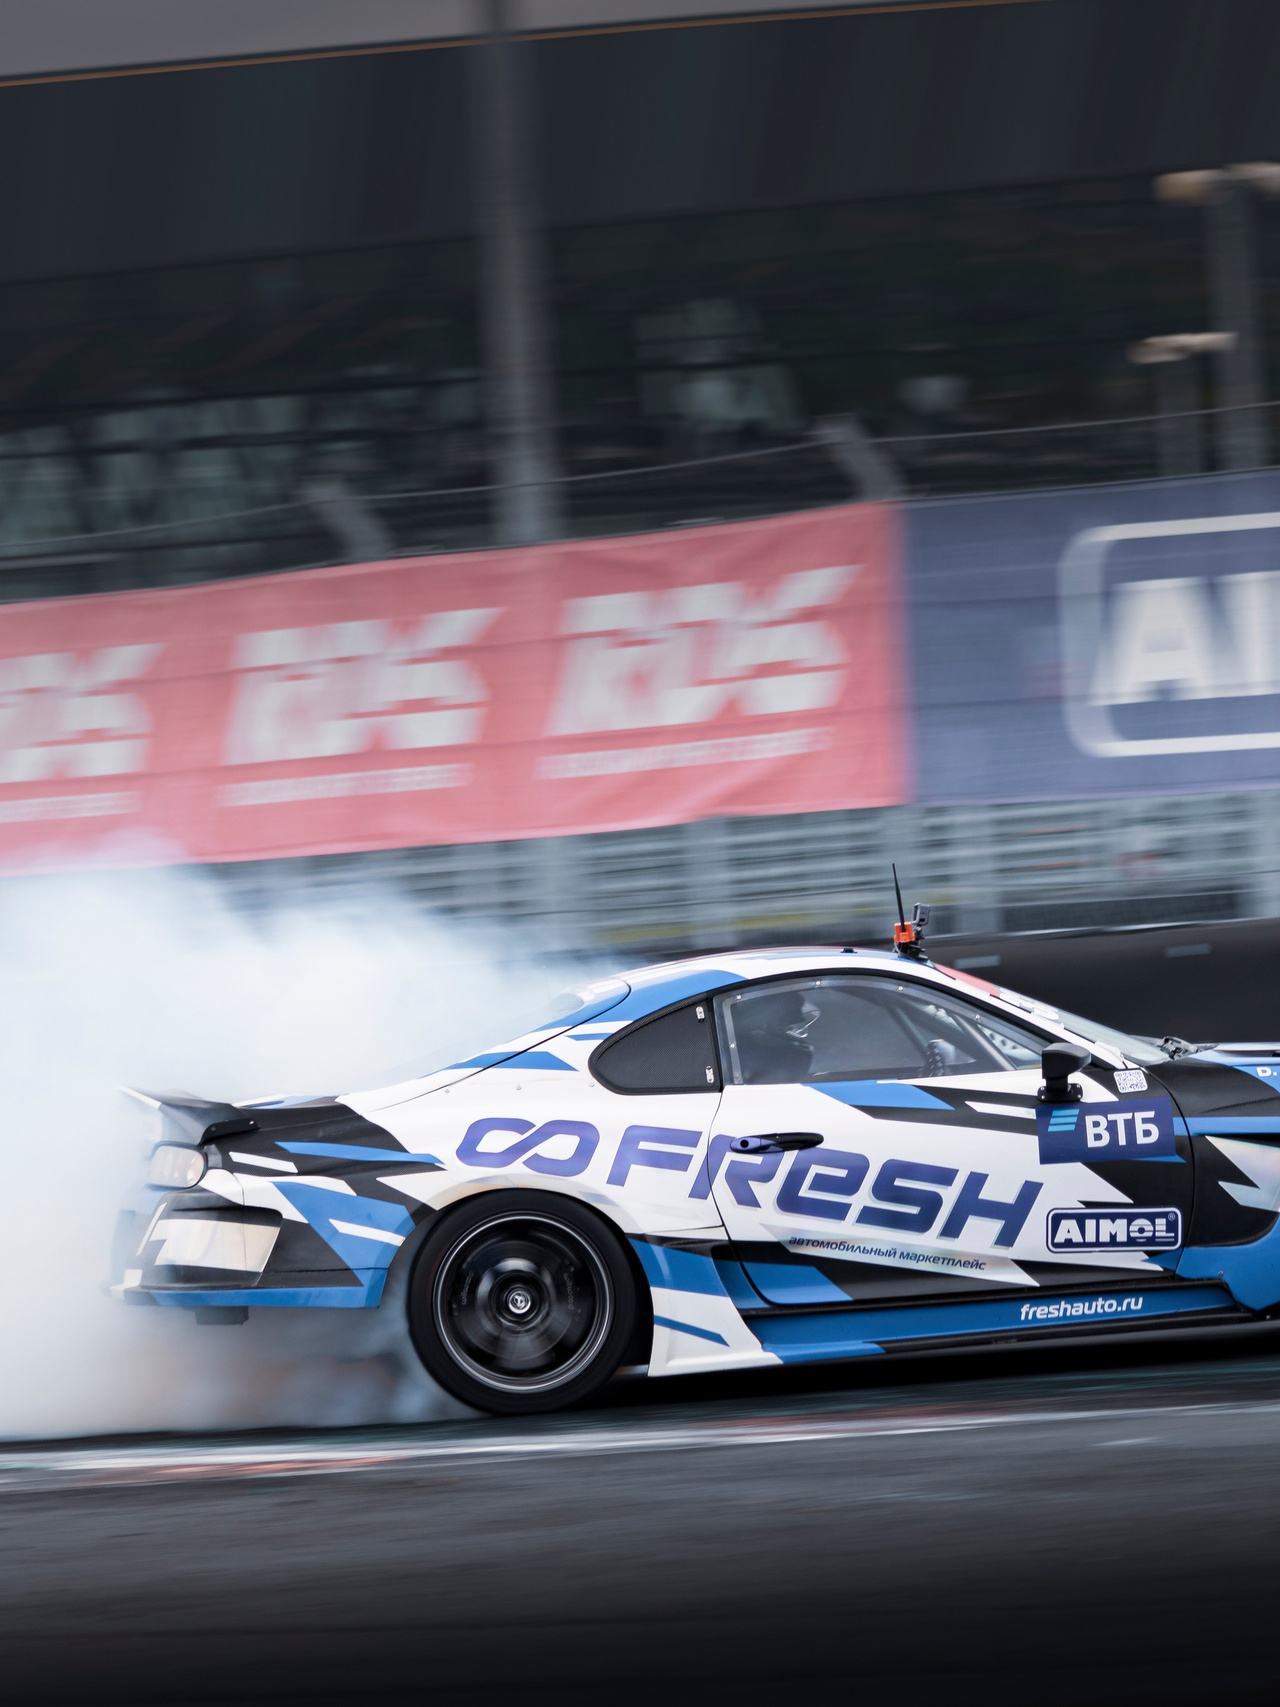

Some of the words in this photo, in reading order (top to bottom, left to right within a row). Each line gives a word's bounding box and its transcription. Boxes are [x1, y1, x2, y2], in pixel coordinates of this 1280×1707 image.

[1256, 1066, 1278, 1077] D.
[1085, 1110, 1159, 1148] ВТБ
[1053, 1218, 1175, 1243] AIMOL
[788, 1235, 898, 1259] автомобильный
[899, 1250, 987, 1271] маркетплейс
[1020, 1297, 1143, 1320] freshauto.ru
